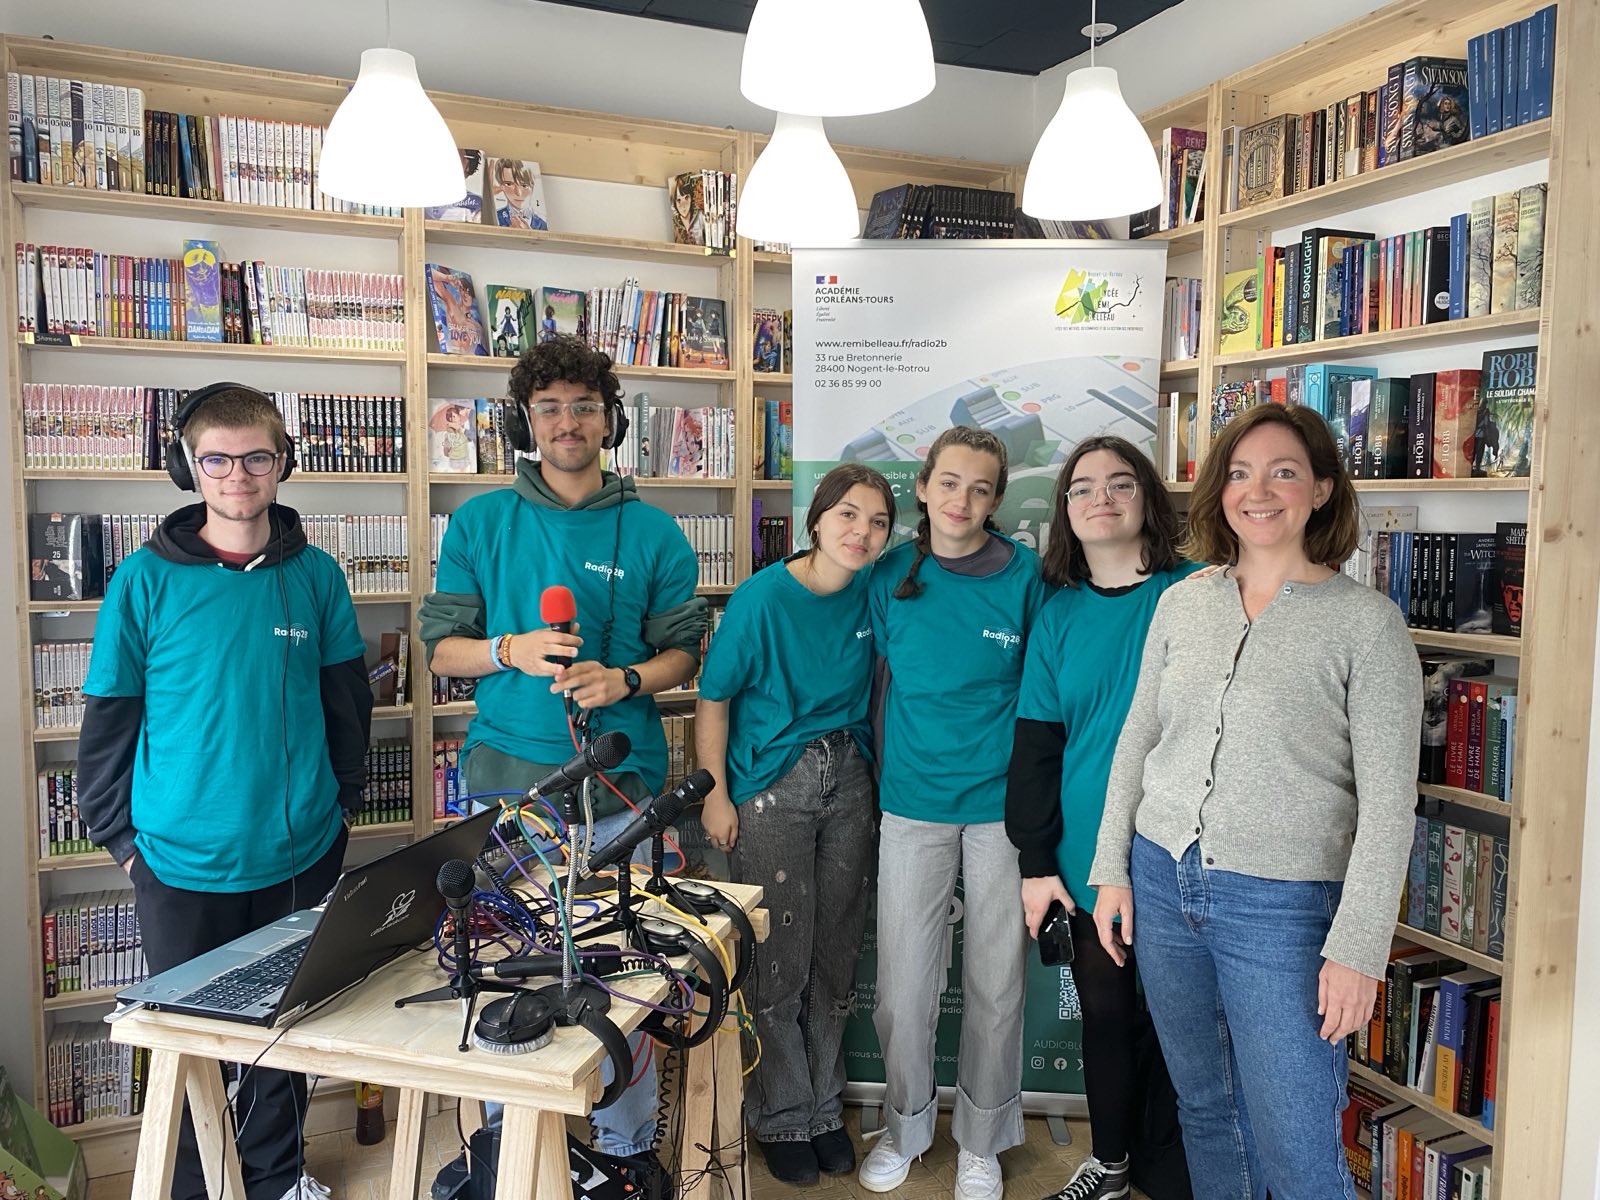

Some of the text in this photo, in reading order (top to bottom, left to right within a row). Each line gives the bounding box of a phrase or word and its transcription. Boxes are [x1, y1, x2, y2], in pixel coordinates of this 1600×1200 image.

[1422, 66, 1448, 85] SWAN
[1404, 77, 1416, 113] SONG
[1388, 82, 1400, 120] SONG
[1402, 113, 1414, 149] SWAN
[1387, 120, 1398, 154] SWAN
[1303, 236, 1312, 299] SONGLIGHT
[496, 290, 526, 300] NANA
[815, 286, 860, 295] ACADÉMIE
[815, 295, 894, 304] D'ORLÉANS-TOURS
[815, 339, 947, 348] www.remibelleau.fr/radio2b
[815, 354, 826, 362] 33
[846, 353, 903, 362] Bretonnerie
[815, 364, 930, 374] 28400 Nogent-le-Rotrou
[815, 380, 882, 388] 02 36 85 99 00
[1020, 382, 1040, 392] SUB
[1486, 390, 1494, 398] LE
[1495, 389, 1516, 397] SOLDAT
[916, 424, 936, 435] SUB
[1374, 435, 1382, 465] HOBB
[1416, 432, 1425, 464] HOBB
[52, 551, 61, 559] 25
[585, 561, 625, 579] Radio2B
[982, 629, 1020, 645] Radio2B
[1450, 762, 1456, 773] LE
[1457, 764, 1462, 775] DE
[1468, 766, 1473, 777] LE
[1491, 746, 1500, 786] TERREMER
[1474, 769, 1480, 780] DE
